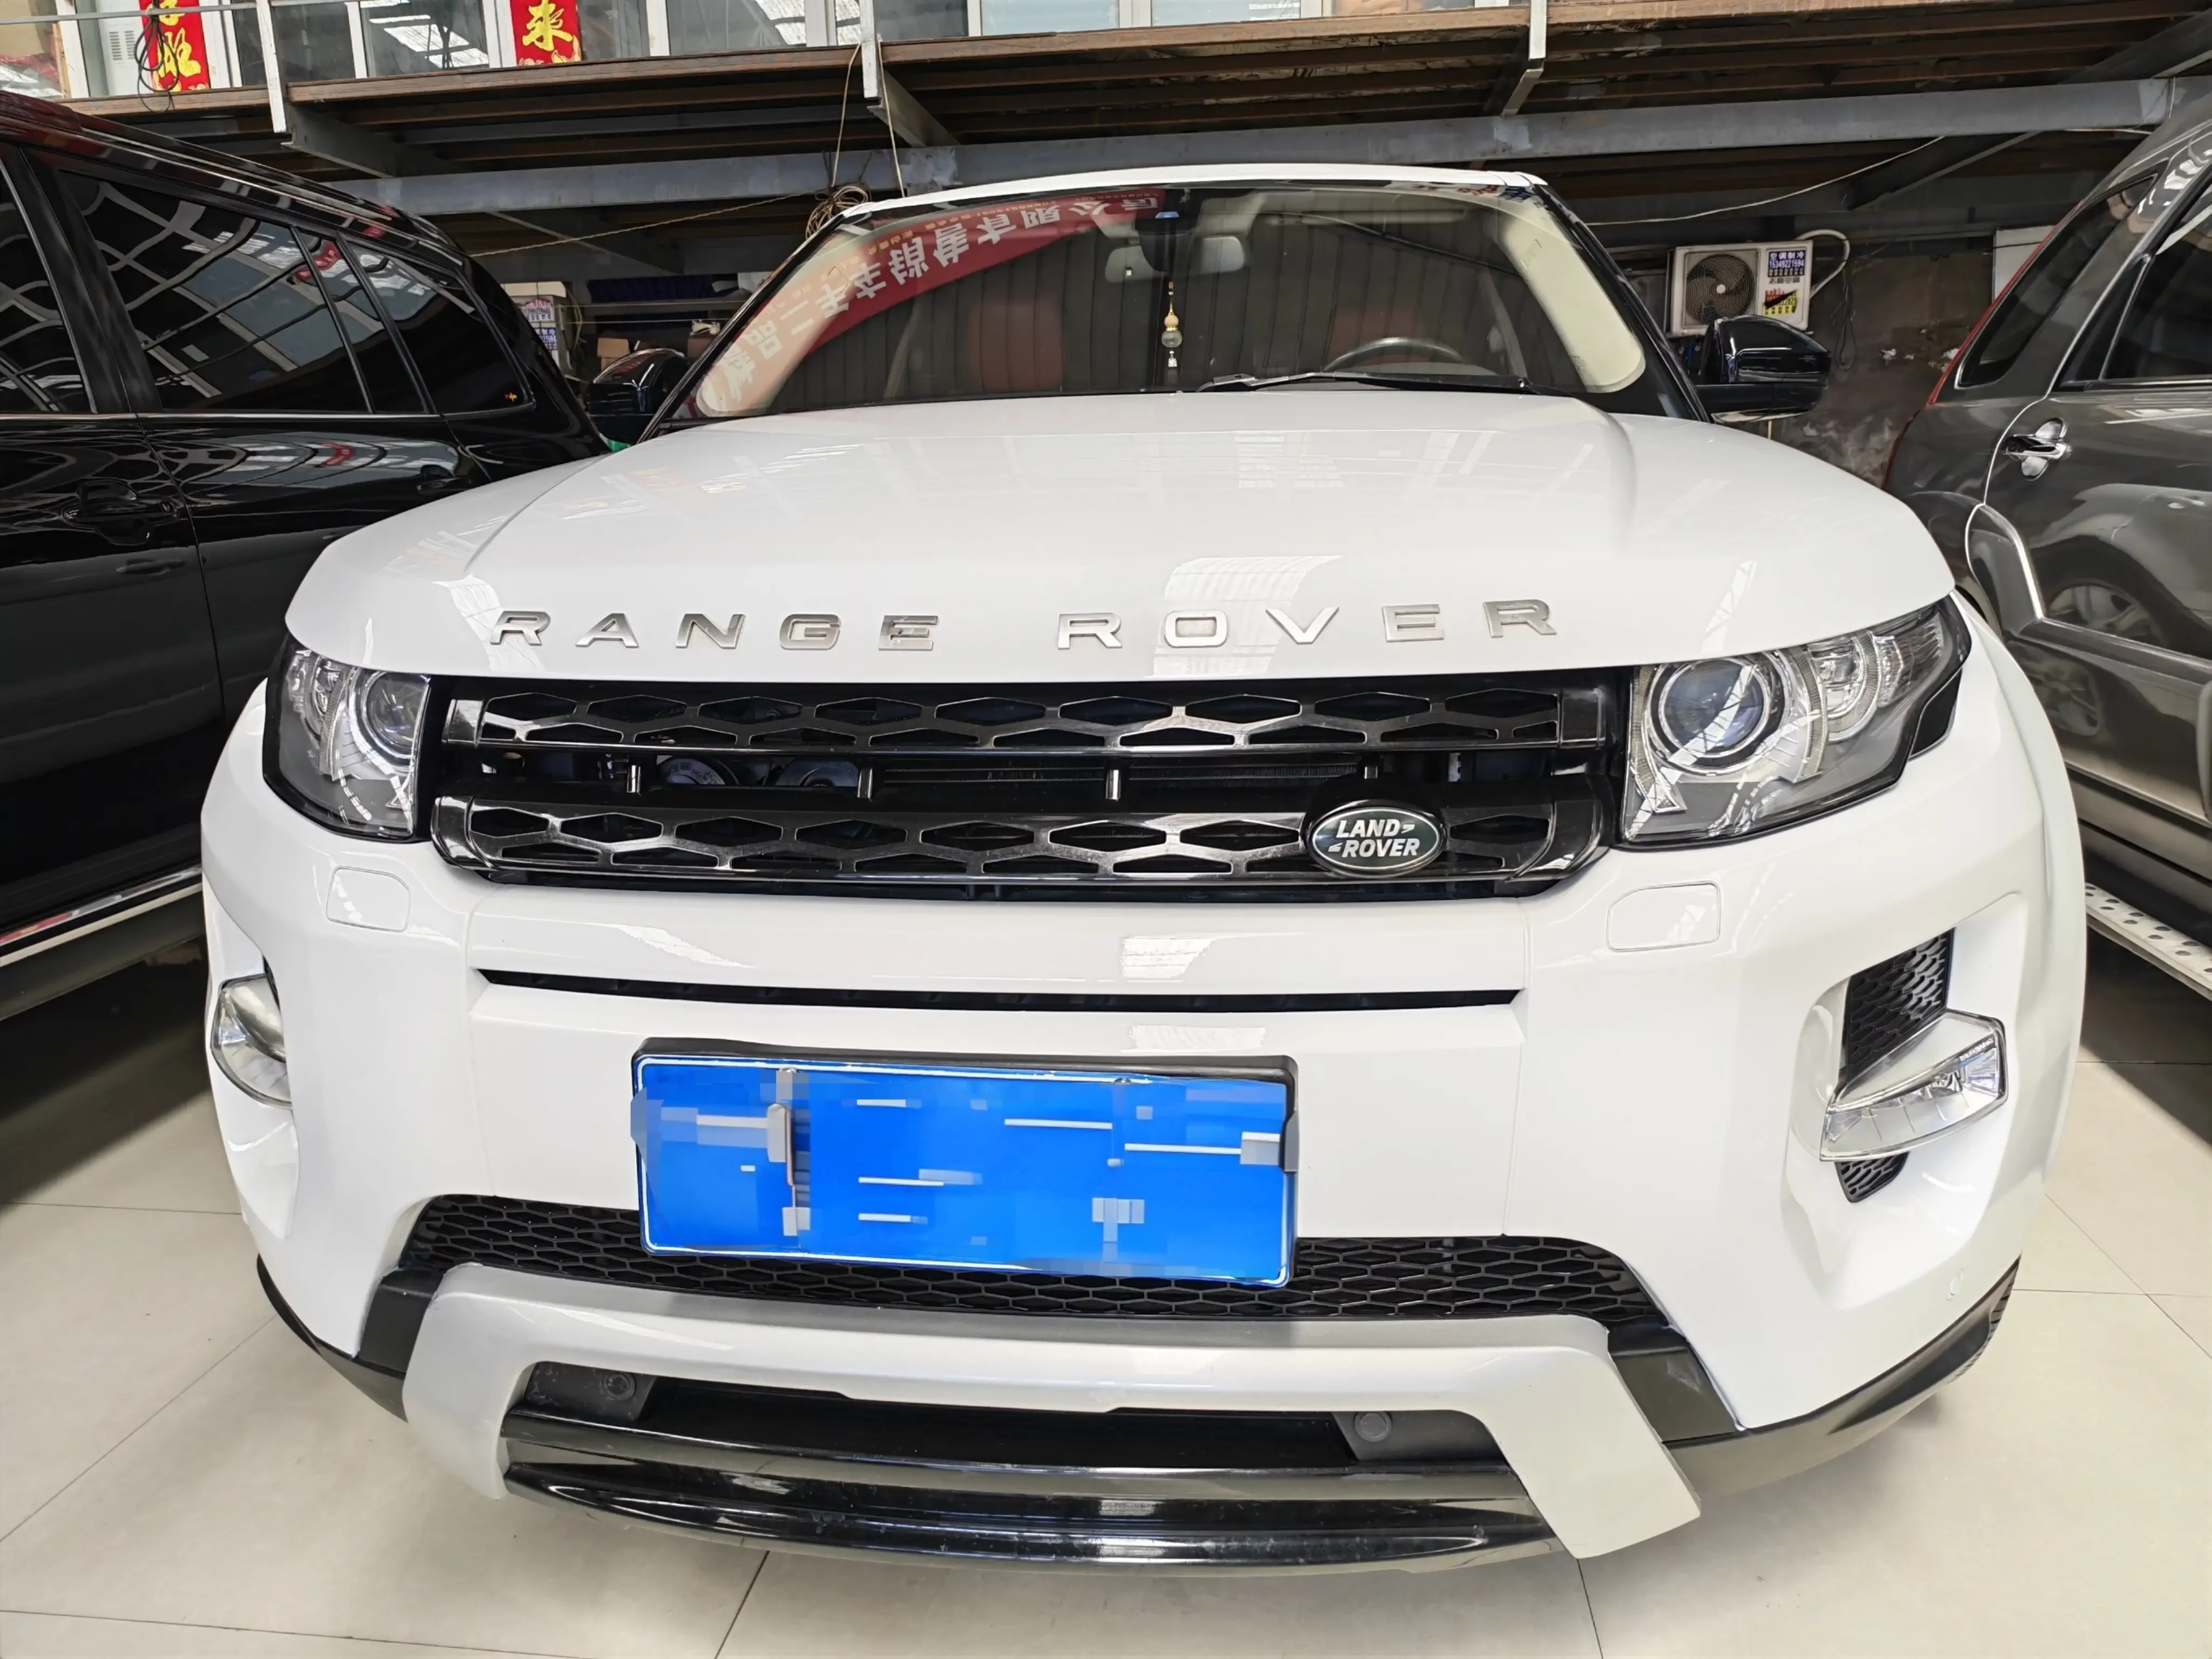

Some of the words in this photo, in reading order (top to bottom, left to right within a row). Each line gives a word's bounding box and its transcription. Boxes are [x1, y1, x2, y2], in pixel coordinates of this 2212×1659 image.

[489, 610, 940, 651] RANGE
[1057, 598, 1557, 650] ROVER
[1336, 818, 1401, 838] LAND
[1341, 838, 1420, 858] ROVER
